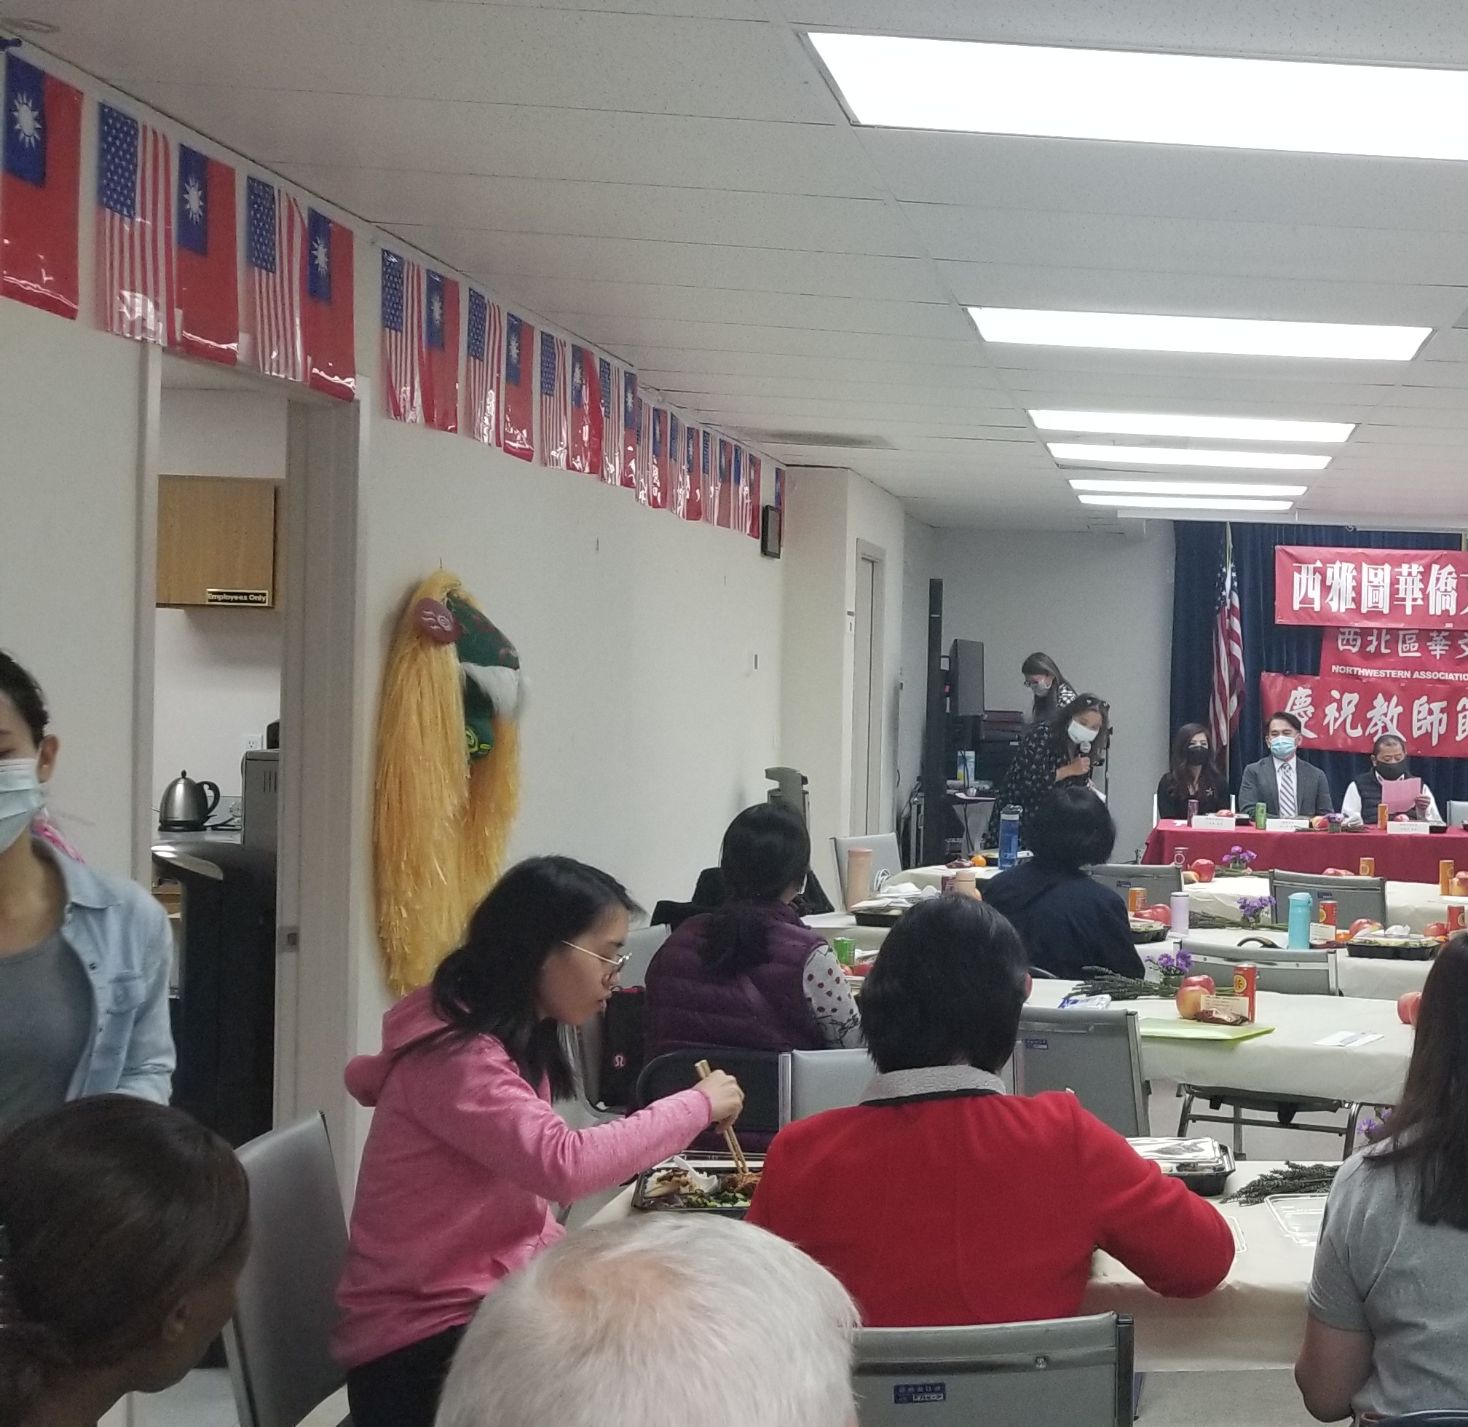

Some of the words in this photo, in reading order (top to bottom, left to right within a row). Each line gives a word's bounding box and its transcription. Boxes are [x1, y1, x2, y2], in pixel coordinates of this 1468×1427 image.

[208, 593, 247, 601] Employees
[249, 594, 266, 602] Only
[1331, 665, 1411, 679] NORTHWESTERN
